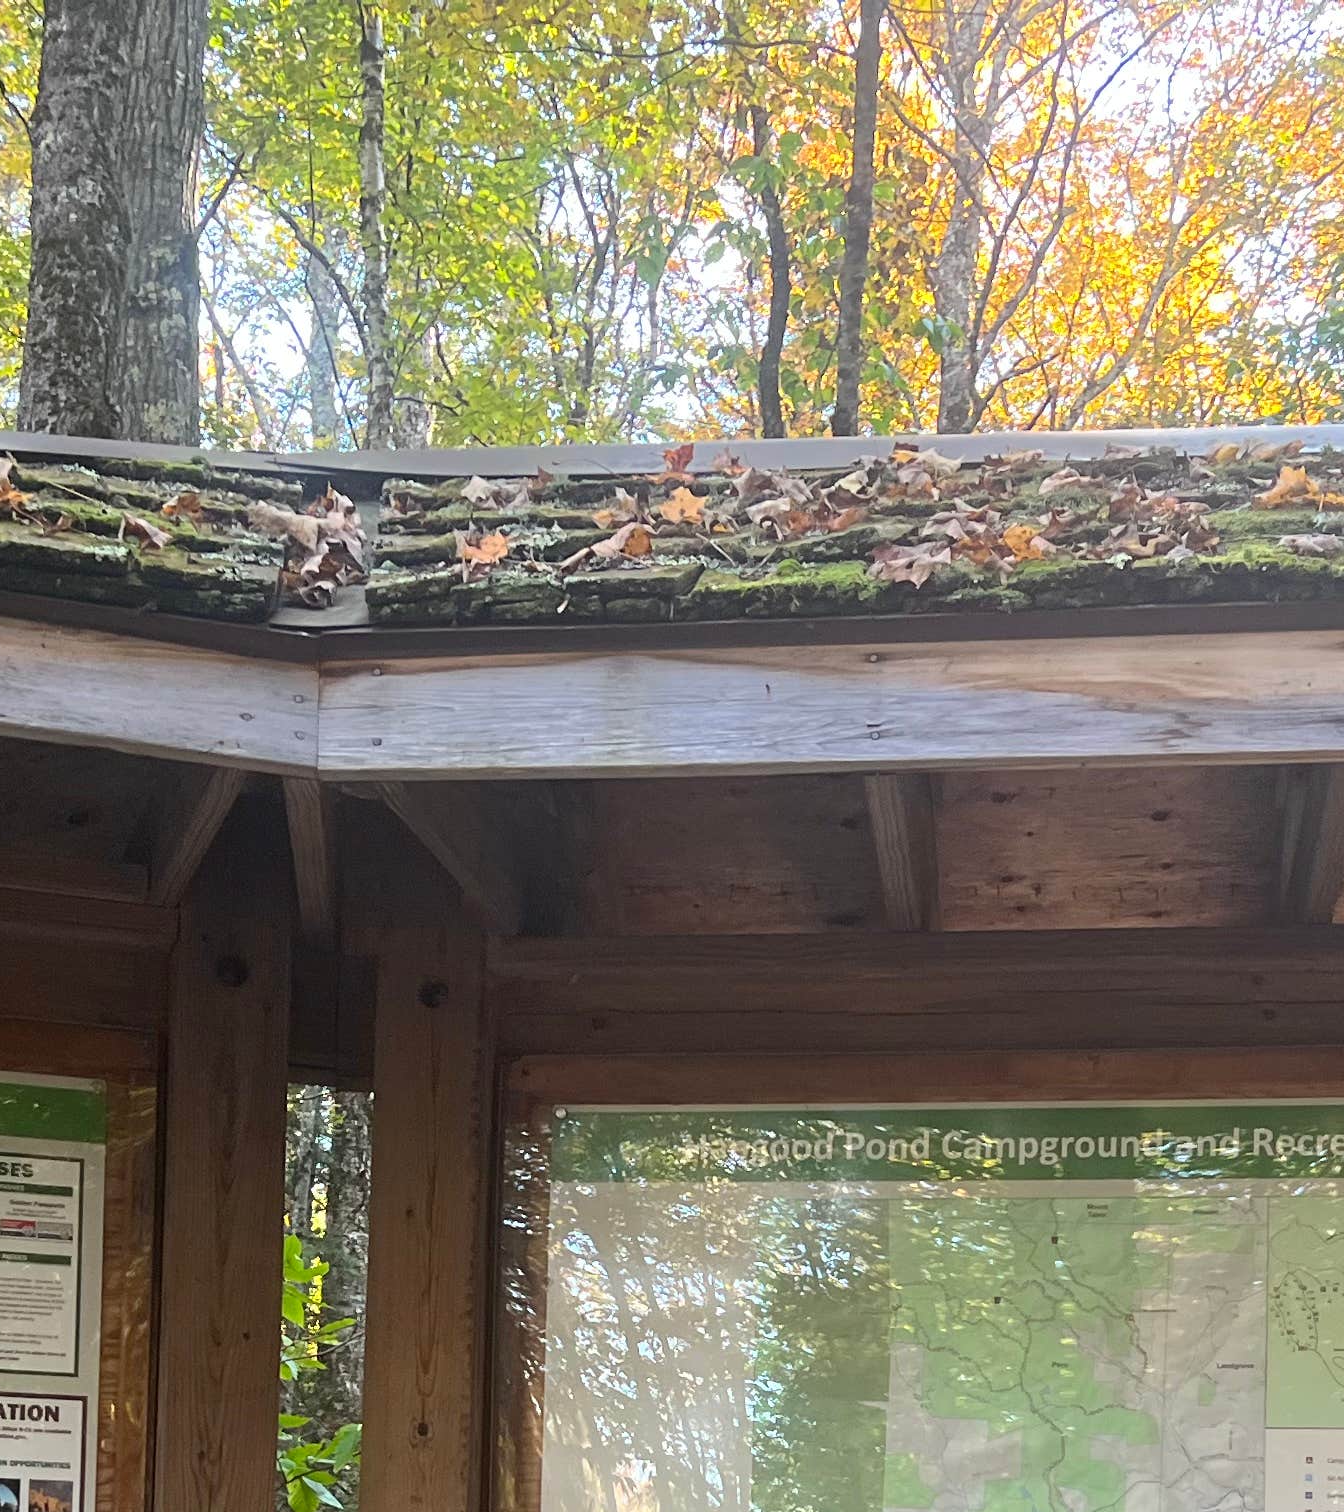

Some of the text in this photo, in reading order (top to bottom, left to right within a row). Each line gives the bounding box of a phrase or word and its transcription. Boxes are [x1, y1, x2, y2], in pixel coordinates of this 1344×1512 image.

[845, 1131, 931, 1161] Pond
[942, 1128, 1163, 1166] Campground
[1175, 1127, 1241, 1158] and
